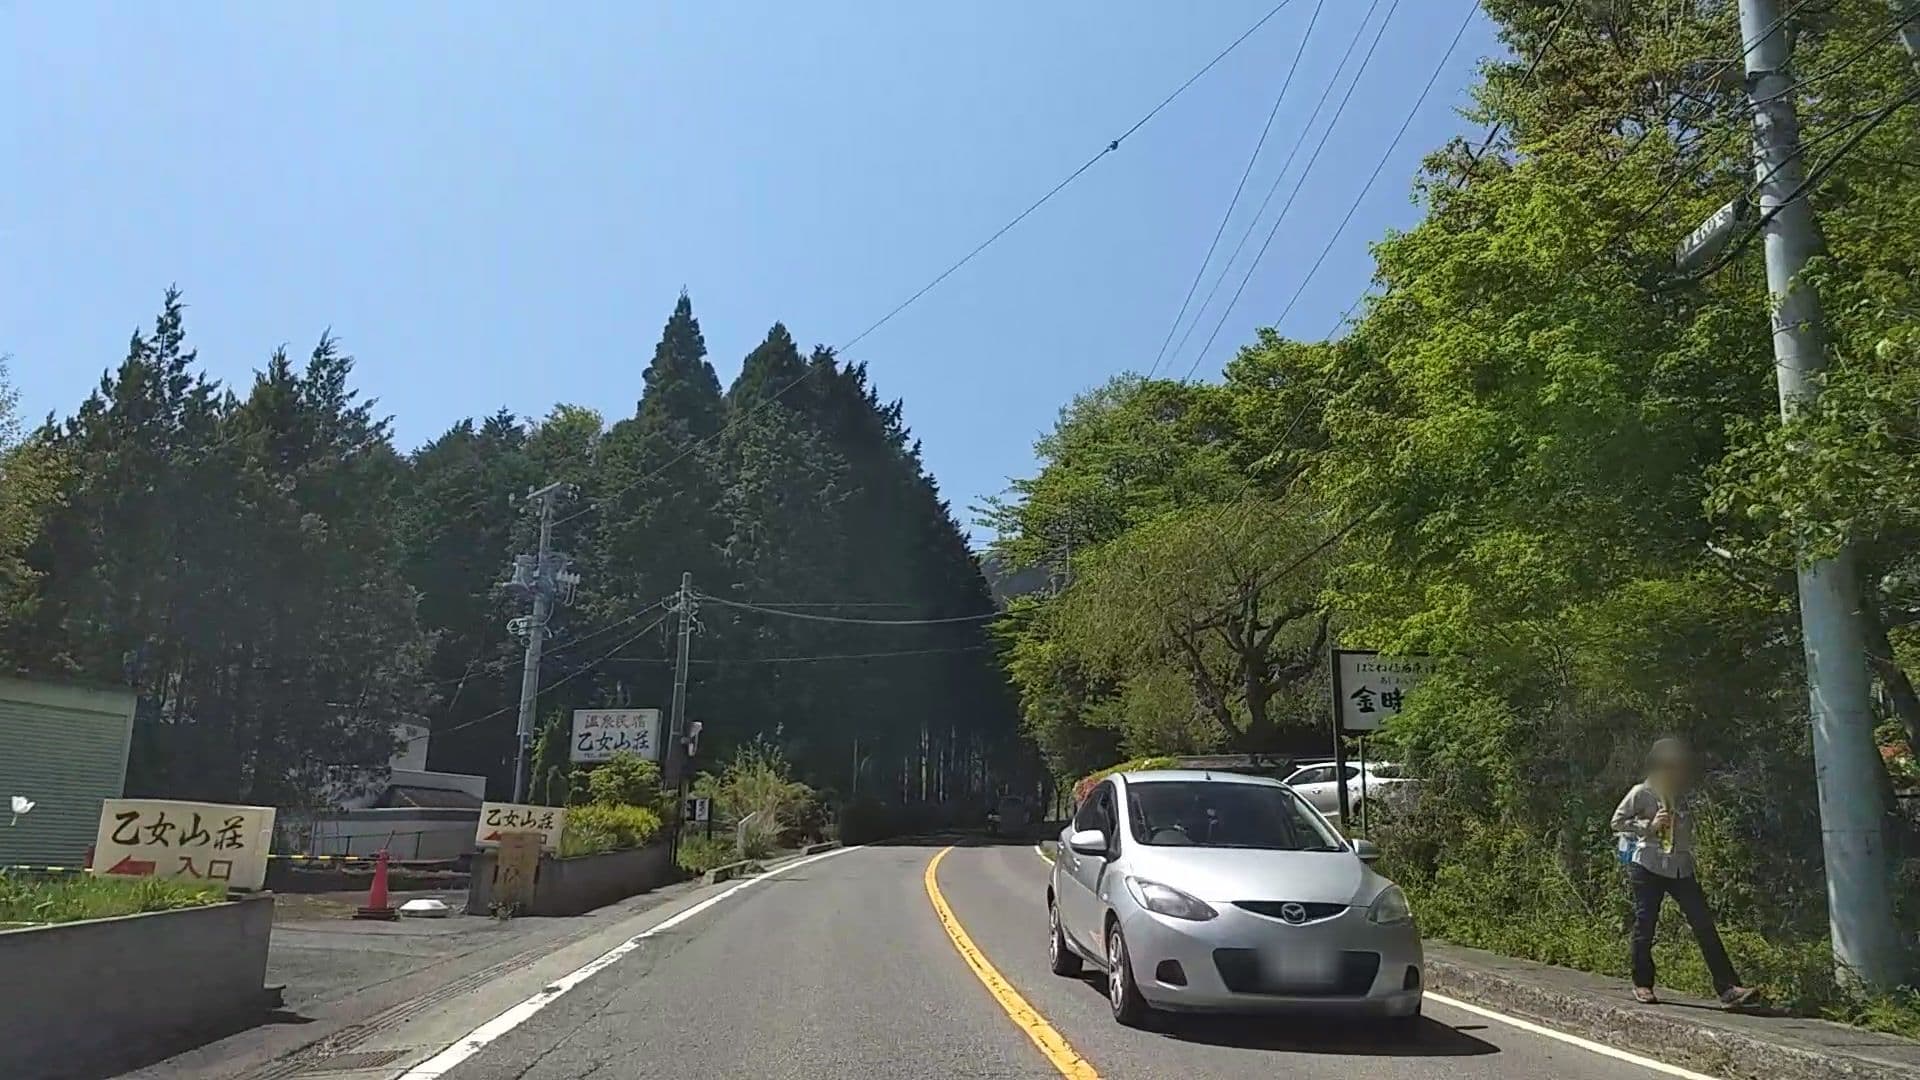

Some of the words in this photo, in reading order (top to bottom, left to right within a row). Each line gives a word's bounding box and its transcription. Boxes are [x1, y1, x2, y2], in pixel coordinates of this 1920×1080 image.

[584, 713, 648, 729] 温泉民宿
[577, 730, 650, 752] 乙女山荘
[486, 808, 555, 830] 乙女山荘
[111, 811, 245, 851] 乙女山荘
[176, 856, 233, 881] 入口
